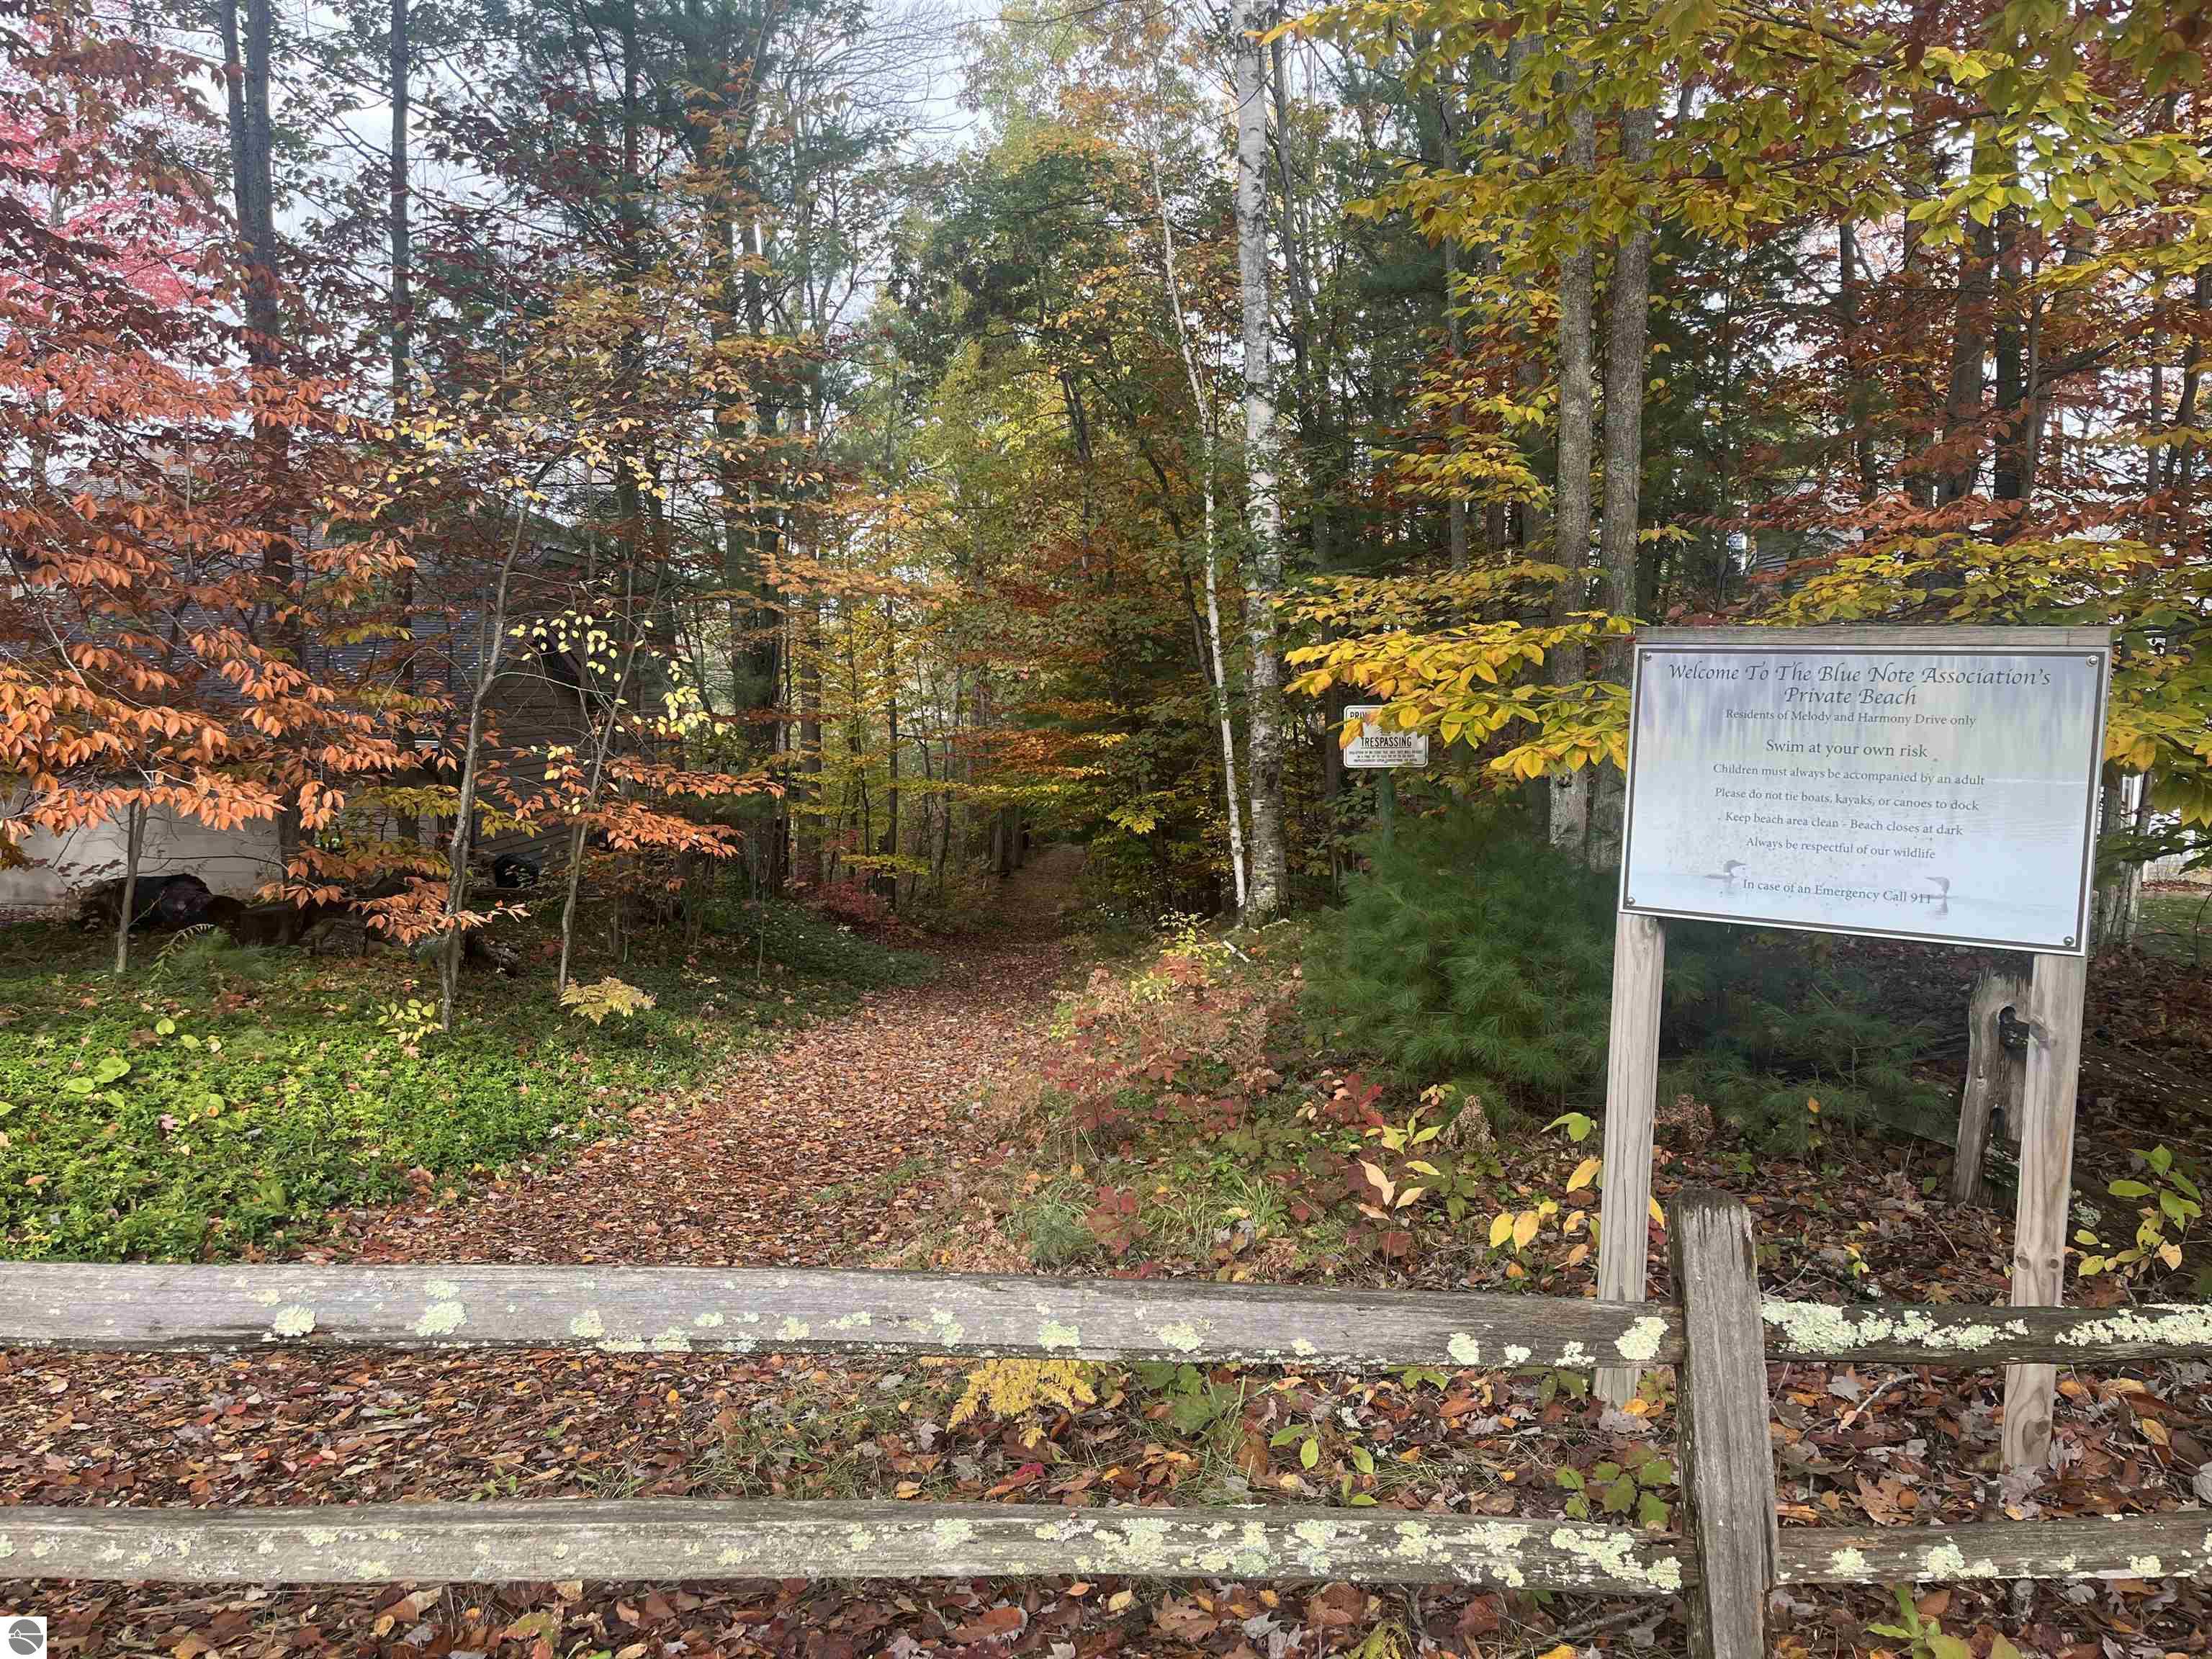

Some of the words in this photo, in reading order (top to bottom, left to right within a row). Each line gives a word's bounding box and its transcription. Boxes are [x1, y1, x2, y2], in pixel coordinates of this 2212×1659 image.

[1669, 661, 1740, 680] Welcome
[1745, 660, 1769, 680] To
[1775, 661, 1812, 681] The
[1818, 662, 1861, 682] Blue
[1868, 662, 1915, 683] Note
[1784, 687, 1852, 703] Private
[1859, 685, 1917, 705] Beach
[1726, 709, 1774, 720] Residents
[1777, 709, 1788, 720] of
[1791, 710, 1830, 725] Melody
[1835, 711, 1855, 722] and
[1858, 712, 1912, 727] Harmony
[1915, 714, 1947, 725] Drive
[1950, 714, 1977, 728] only
[1361, 737, 1412, 747] TRESPASSING
[1766, 739, 1804, 753] Swim
[1808, 742, 1821, 753] at
[1826, 744, 1859, 757] your
[1863, 745, 1894, 756] own
[1900, 744, 1928, 757] risk
[1713, 763, 1758, 775] Children
[1761, 768, 1787, 777] must
[1790, 768, 1825, 780] always
[1827, 768, 1840, 778] be
[1843, 771, 1917, 783] accompanied
[1920, 772, 1935, 786] by
[1937, 775, 1951, 784] an
[1954, 774, 1984, 786] adult
[1714, 787, 1746, 799] Please
[1748, 789, 1762, 799] do
[1765, 791, 1783, 801] not
[1785, 792, 1799, 801] tie
[1802, 792, 1833, 804] boats,
[1835, 793, 1875, 806] kayaks,
[1878, 798, 1891, 806] or
[1894, 799, 1932, 808] canoes
[1936, 799, 1947, 809] to
[1950, 799, 1980, 811] dock
[1725, 811, 1751, 824] Keep
[1754, 812, 1784, 824] beach
[1786, 817, 1809, 827] area
[1811, 817, 1838, 828] clean
[1851, 819, 1883, 831] Beach
[1887, 821, 1920, 834] closes
[1922, 824, 1933, 834] at
[1936, 824, 1964, 835] dark
[1745, 837, 1783, 850] Always
[1786, 838, 1798, 850] be
[1801, 841, 1853, 854] respectful
[1856, 844, 1868, 855] of
[1871, 848, 1890, 856] our
[1893, 847, 1936, 859] wildlife
[1743, 878, 1754, 889] In
[1757, 883, 1781, 892] case
[1784, 882, 1796, 893] of
[1797, 885, 1811, 894] an
[1814, 885, 1880, 902] Emergency
[1883, 890, 1907, 902] Call
[1910, 893, 1931, 904] 911
